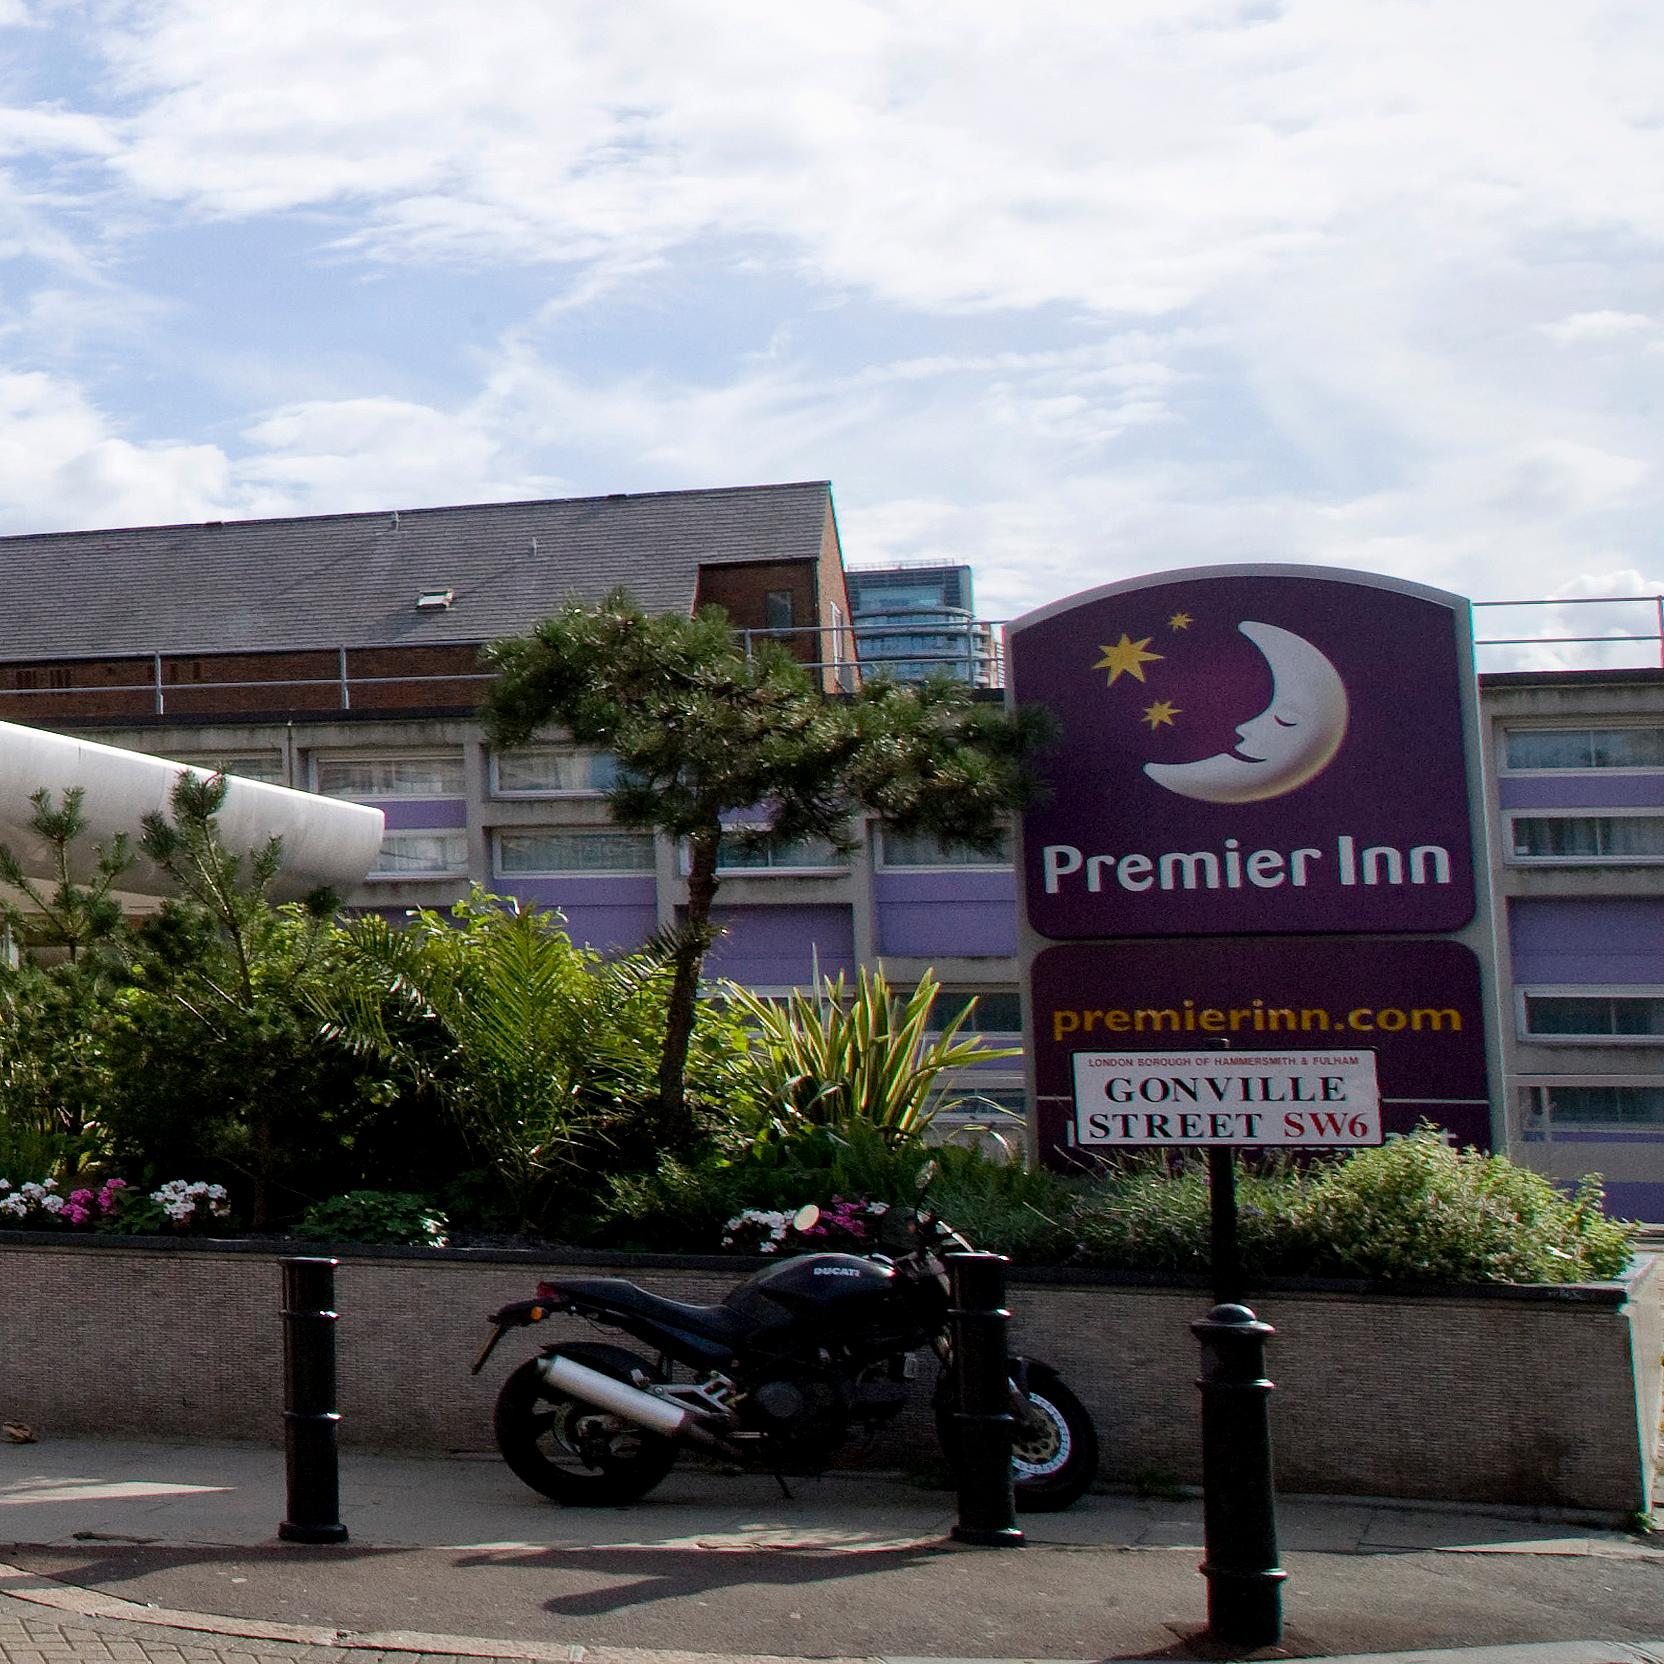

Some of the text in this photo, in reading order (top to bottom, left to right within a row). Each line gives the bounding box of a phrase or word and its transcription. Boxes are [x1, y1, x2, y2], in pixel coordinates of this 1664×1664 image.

[1042, 835, 1452, 894] Premier Inn
[1052, 998, 1463, 1042] premierinn.com
[1088, 1056, 1360, 1068] LONDON BOROUGH OF HAMMERSMITH & FULHAM
[1104, 1076, 1347, 1104] GONVILLE
[1088, 1112, 1263, 1139] STREET
[1283, 1111, 1369, 1138] SW6
[813, 1267, 862, 1277] DUCATI
